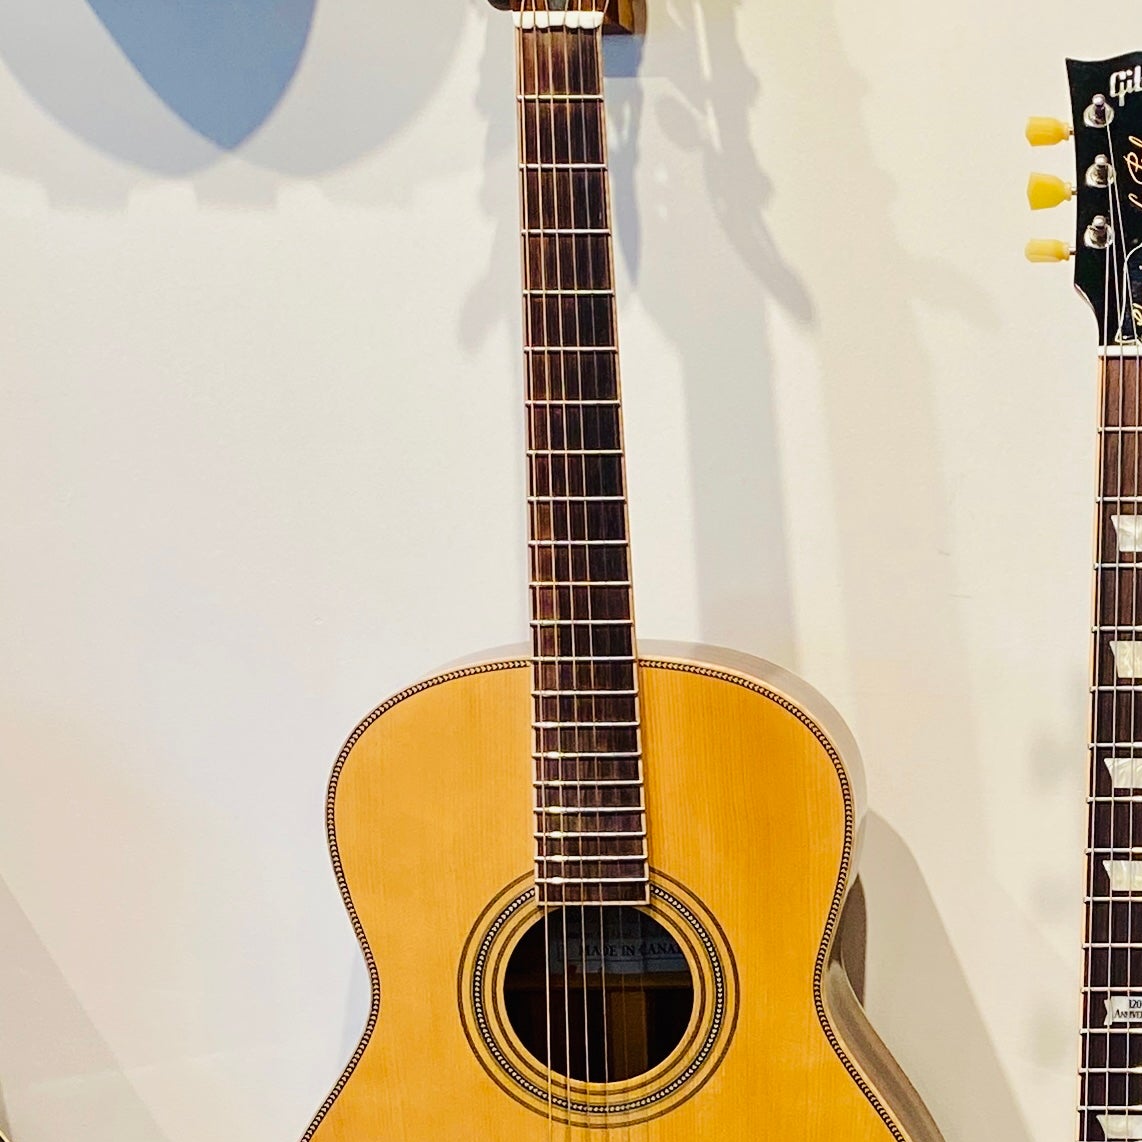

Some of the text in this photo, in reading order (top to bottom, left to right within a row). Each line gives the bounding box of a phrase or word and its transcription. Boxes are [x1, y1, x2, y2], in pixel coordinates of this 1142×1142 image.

[578, 943, 683, 956] MADE IN CANA
